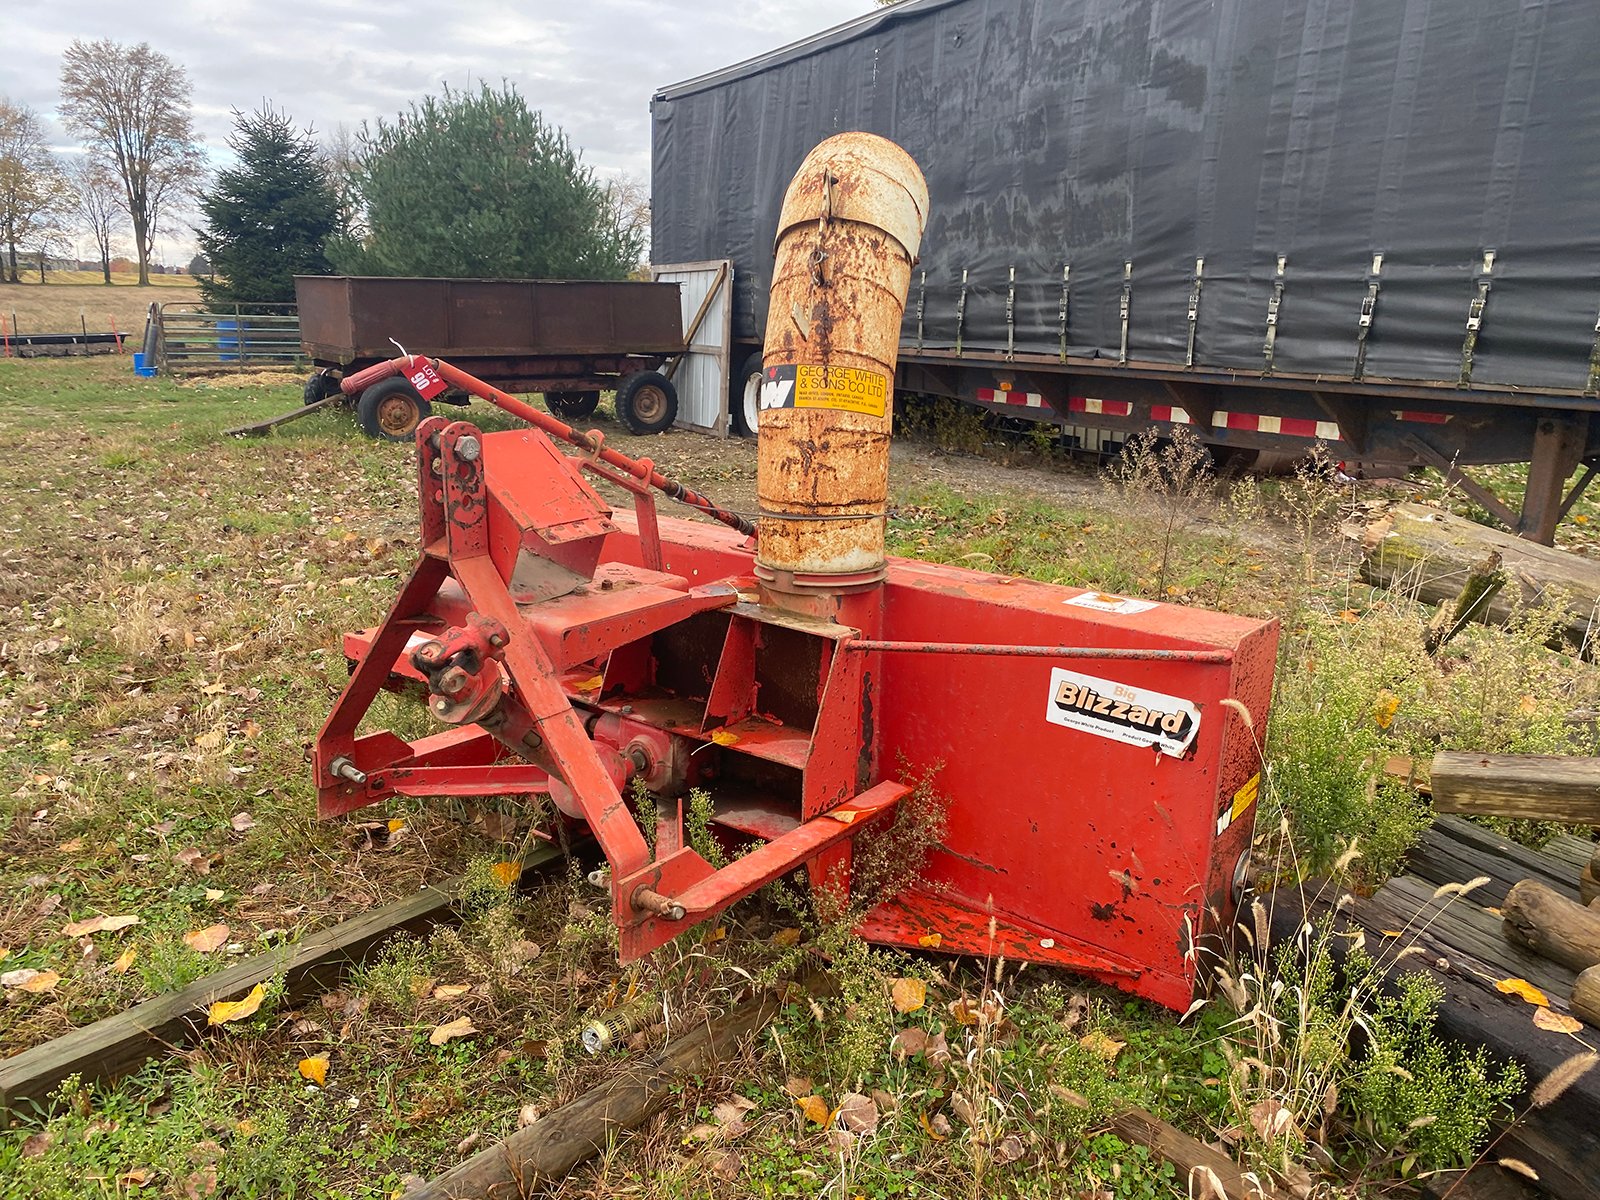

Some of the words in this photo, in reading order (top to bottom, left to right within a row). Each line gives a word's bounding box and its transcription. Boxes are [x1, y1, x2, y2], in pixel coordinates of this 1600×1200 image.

[422, 364, 436, 378] LOT
[799, 366, 851, 380] GEORGE
[854, 370, 884, 387] WHITE
[411, 372, 430, 390] 90
[800, 379, 808, 389] &
[810, 377, 846, 391] SONS
[1113, 686, 1136, 702] Big
[1055, 680, 1192, 739] Blizzard
[1064, 716, 1081, 725] George
[1094, 725, 1115, 734] Product
[1160, 742, 1175, 750] White
